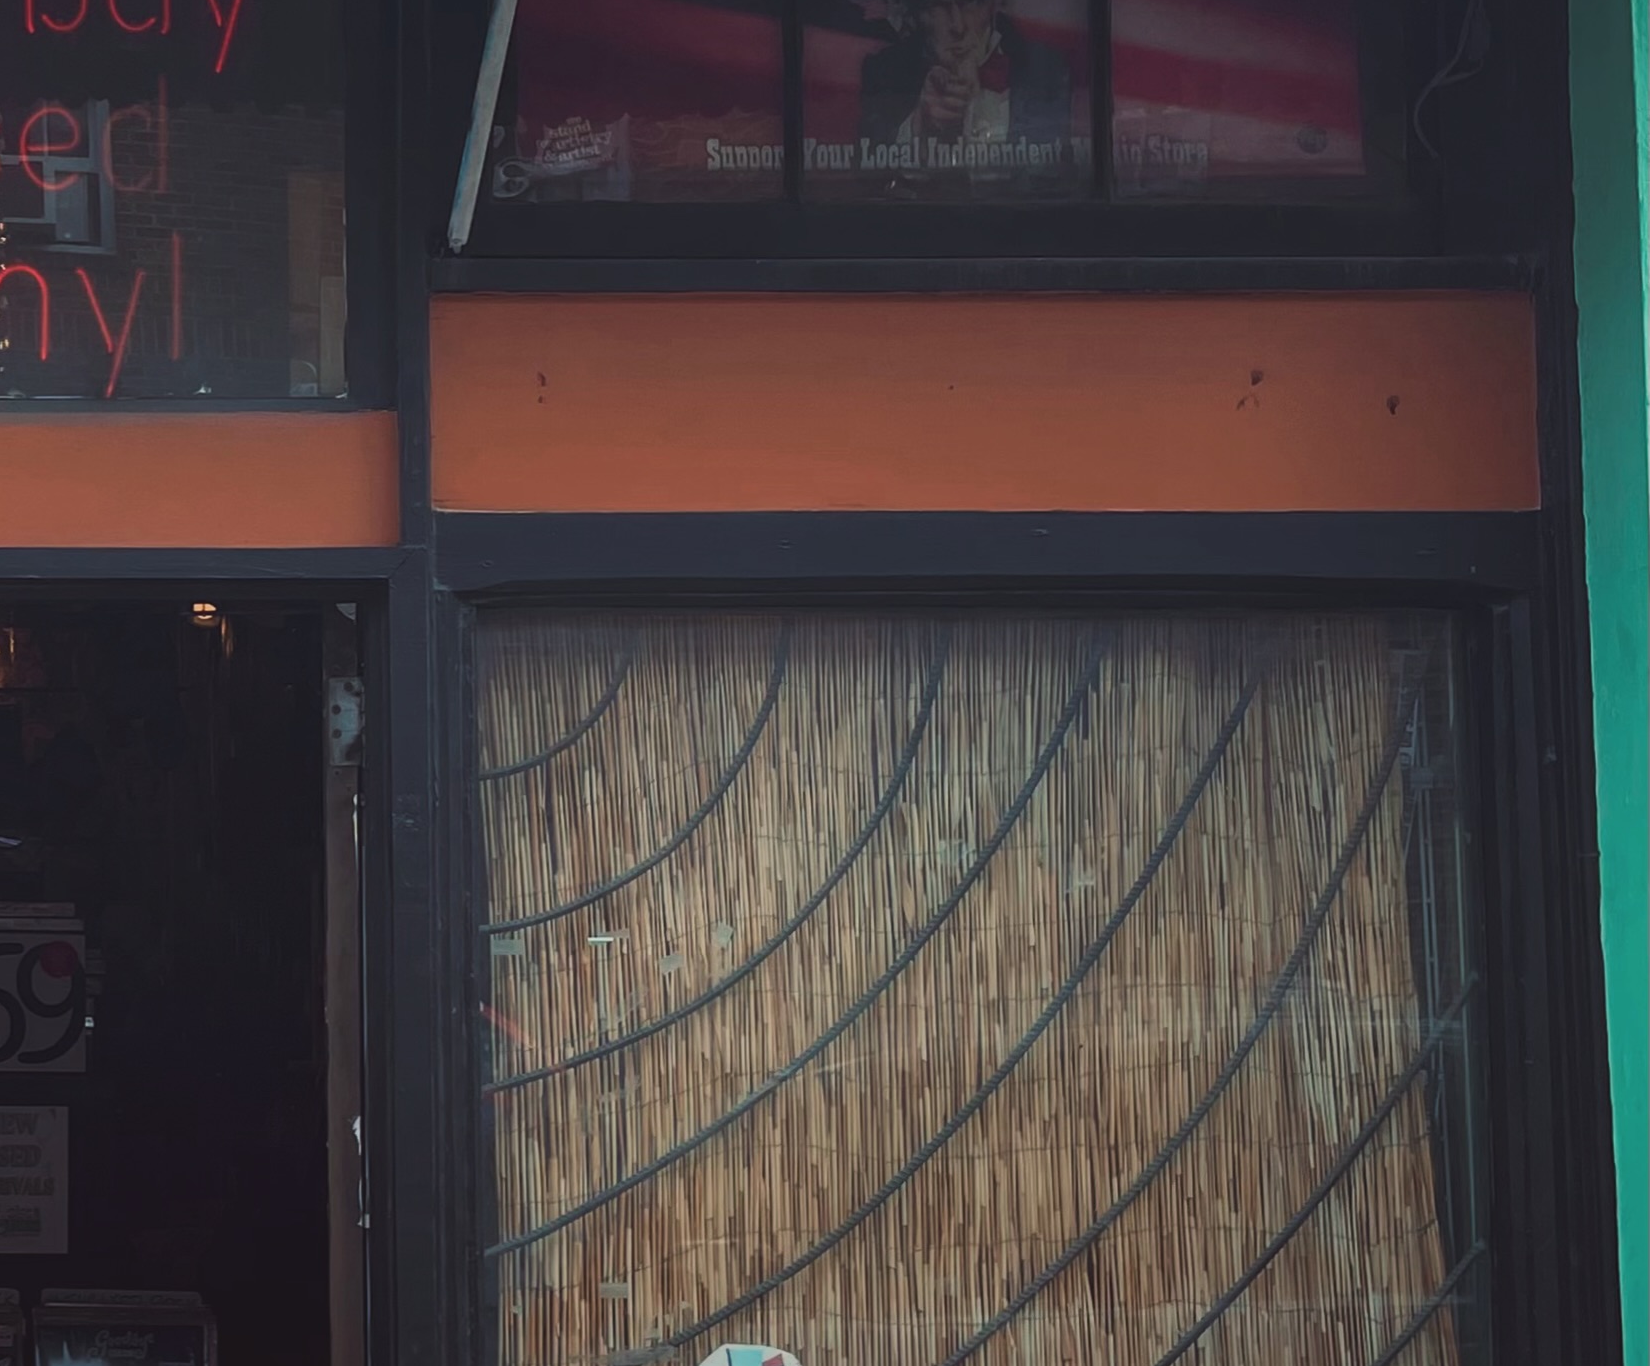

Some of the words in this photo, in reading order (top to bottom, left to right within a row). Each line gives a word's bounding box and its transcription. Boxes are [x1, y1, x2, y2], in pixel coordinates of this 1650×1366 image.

[705, 138, 784, 172] Suppor
[803, 138, 855, 171] Your
[859, 136, 921, 170] Local
[926, 136, 1062, 169] Independent
